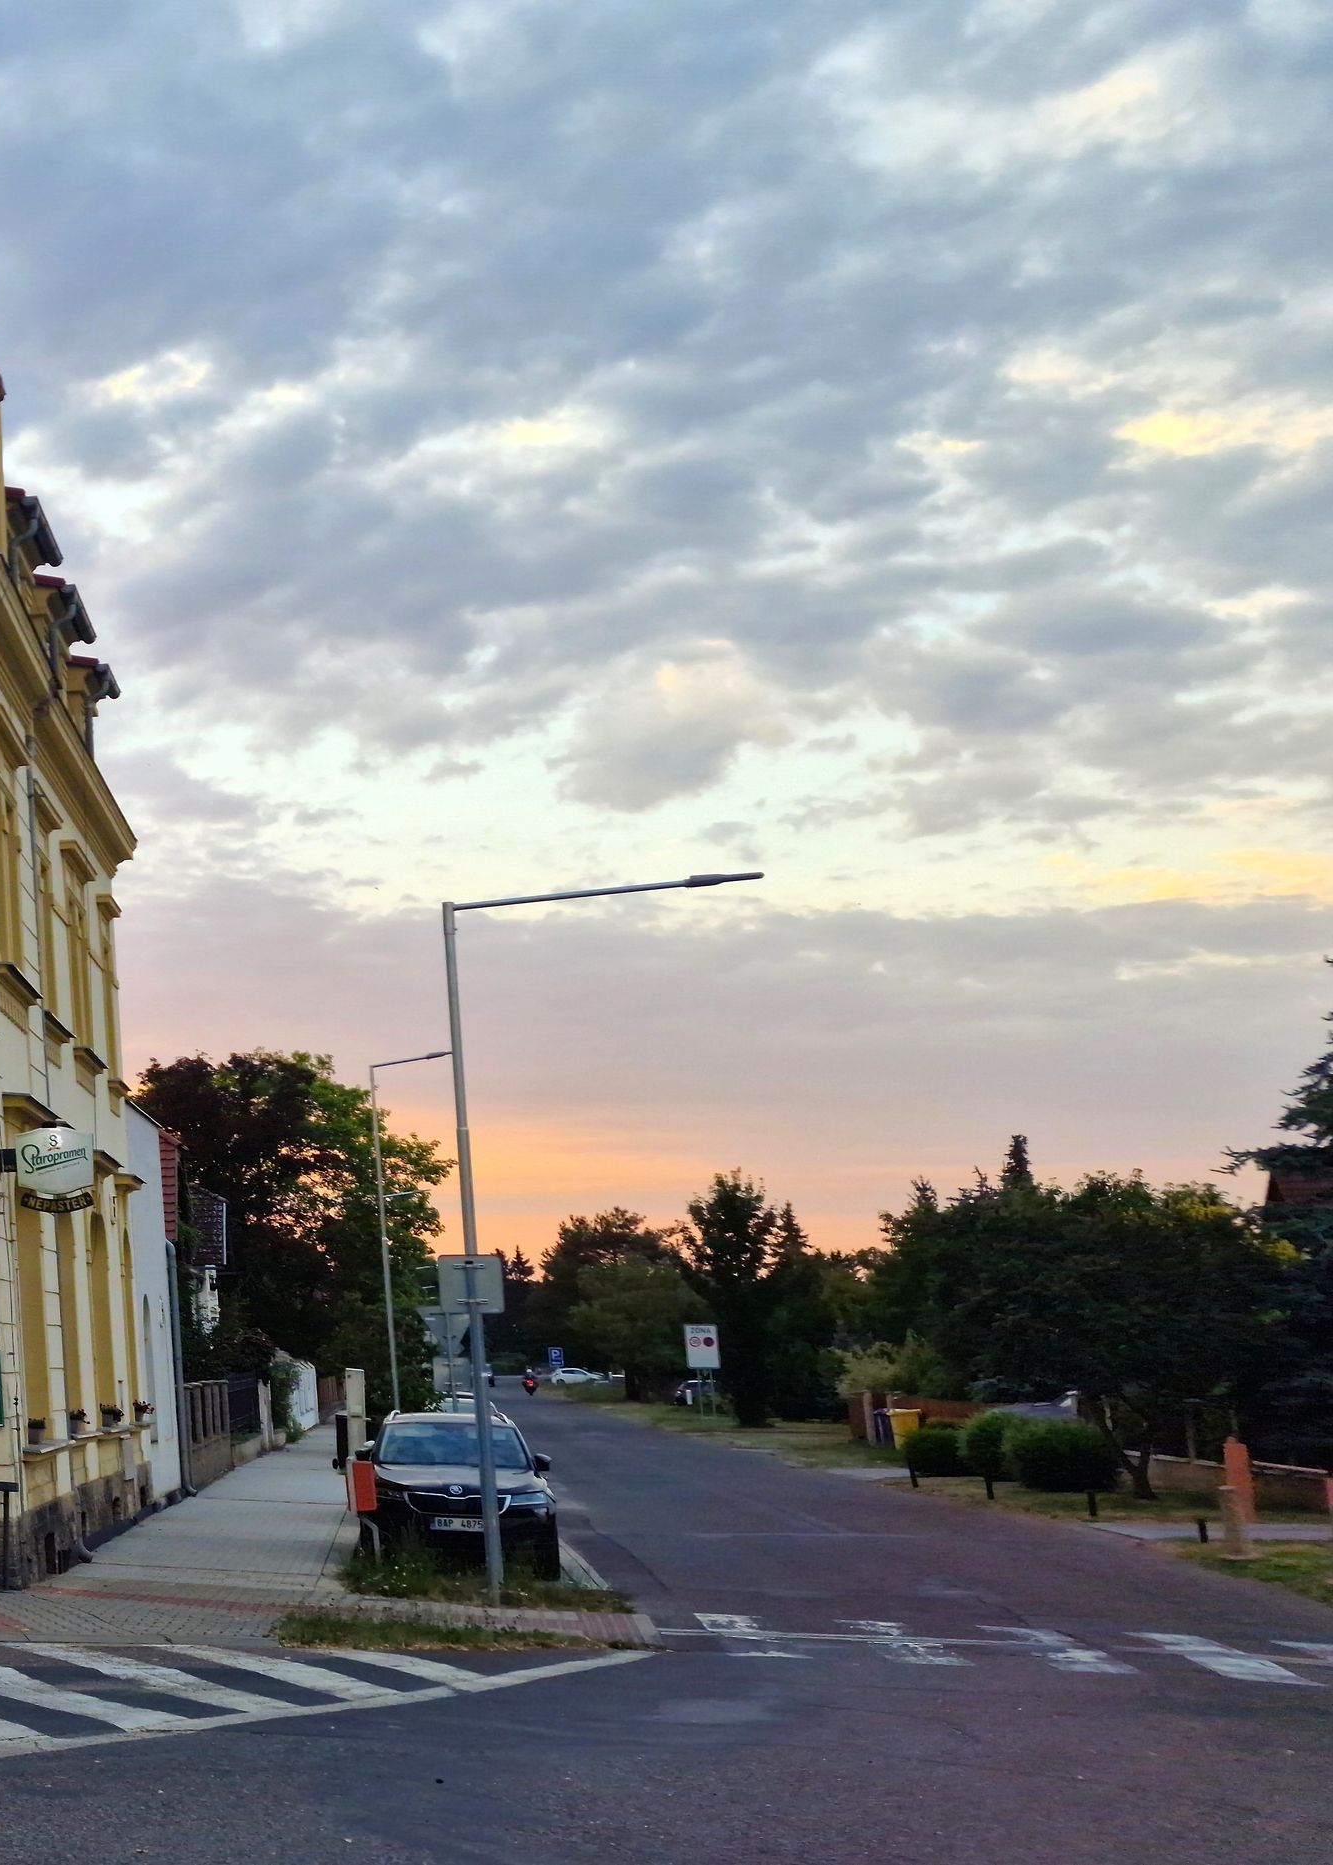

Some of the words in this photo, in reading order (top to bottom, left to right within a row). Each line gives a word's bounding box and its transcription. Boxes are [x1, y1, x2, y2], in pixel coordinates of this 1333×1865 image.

[21, 1144, 89, 1174] Staropramen
[27, 1196, 88, 1211] NEPASTER
[437, 1518, 454, 1528] 8AP
